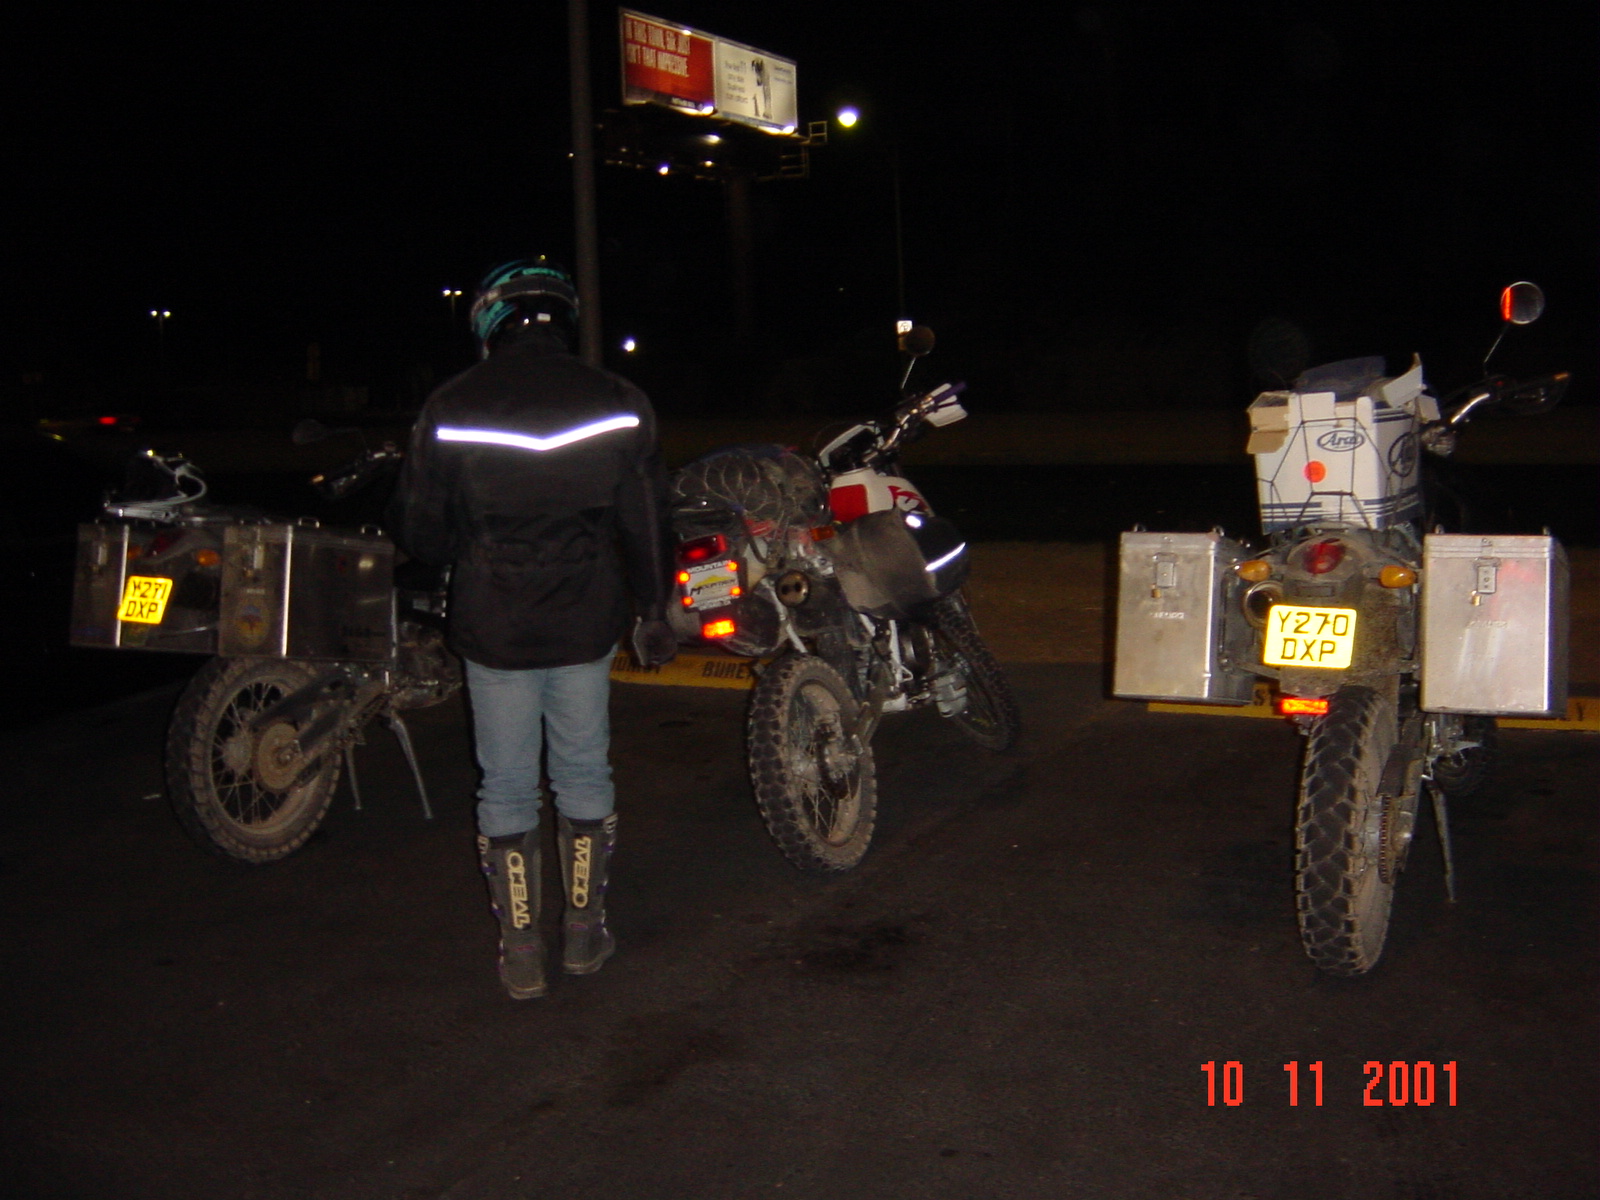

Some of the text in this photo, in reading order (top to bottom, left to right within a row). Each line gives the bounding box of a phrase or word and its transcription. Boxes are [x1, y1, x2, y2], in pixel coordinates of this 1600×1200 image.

[132, 580, 168, 599] Y271
[125, 601, 158, 618] DXP
[1278, 611, 1349, 636] Y270
[1281, 638, 1336, 662] DXP
